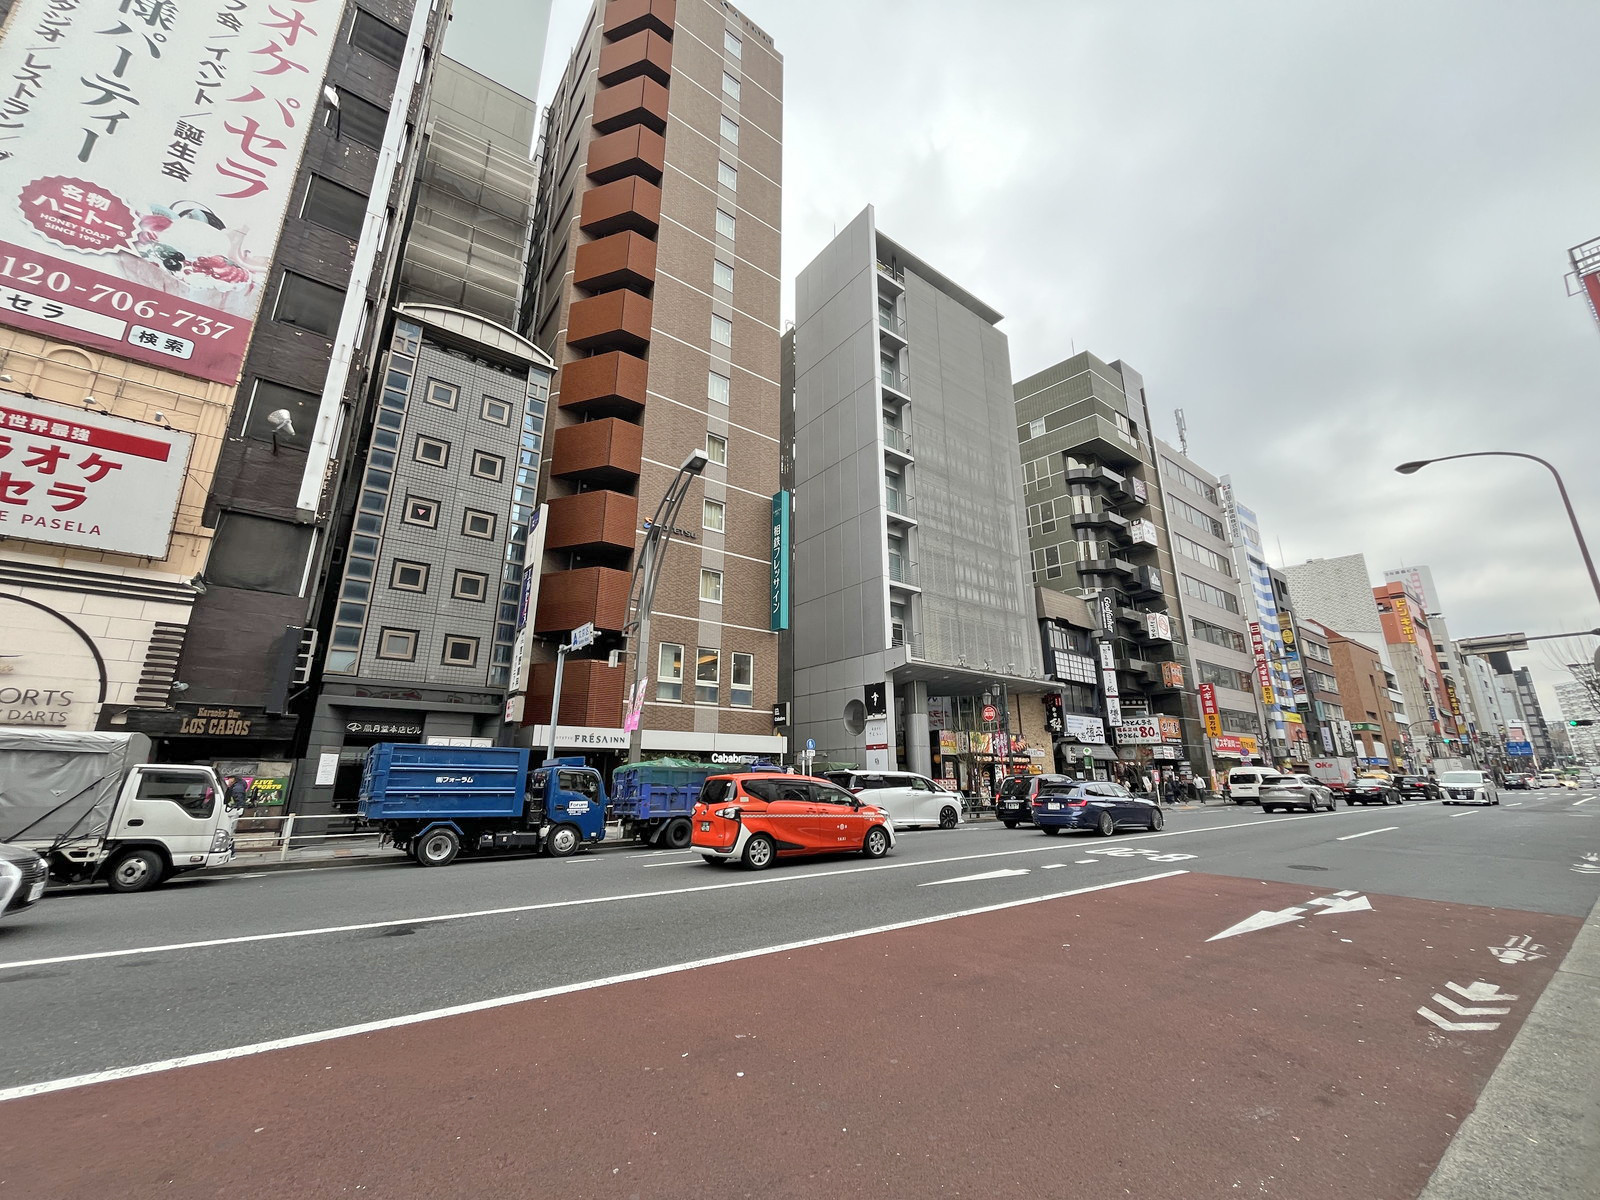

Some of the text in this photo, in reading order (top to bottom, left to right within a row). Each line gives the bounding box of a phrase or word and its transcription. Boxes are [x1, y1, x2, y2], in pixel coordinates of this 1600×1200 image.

[215, 0, 318, 199] オケパセラ
[60, 184, 112, 212] 名物
[31, 194, 124, 230] ハニトー
[40, 212, 111, 241] HONEY TOAST
[45, 222, 102, 245] SINCE 1993
[138, 330, 184, 354] 検索
[20, 513, 102, 536] PASELA
[773, 523, 781, 613] 相鉄フレッサイン
[1103, 596, 1114, 633] Godfather
[8, 709, 68, 722] DARTS
[197, 707, 241, 718] Karaoke Bar
[179, 717, 252, 736] LOS CABOS
[574, 733, 608, 743] FRÉSA
